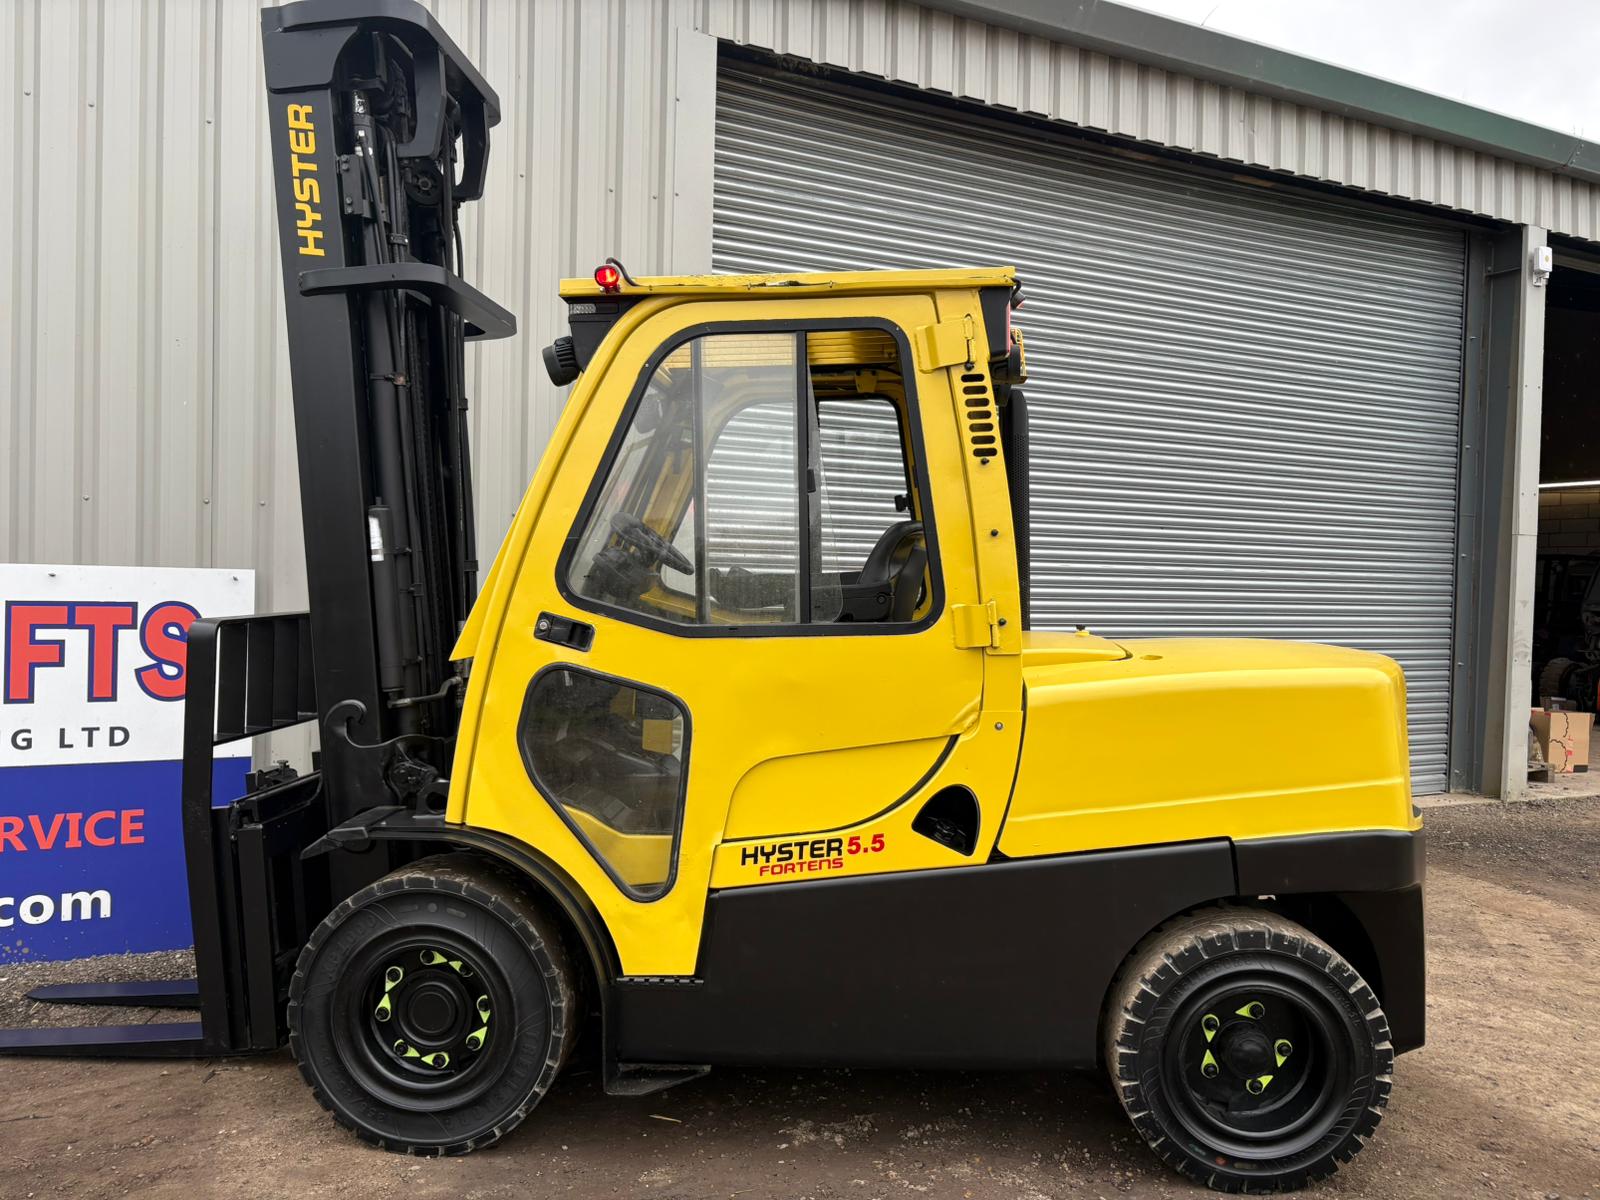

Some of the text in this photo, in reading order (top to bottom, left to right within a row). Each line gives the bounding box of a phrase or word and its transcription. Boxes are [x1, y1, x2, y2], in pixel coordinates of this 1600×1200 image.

[287, 103, 326, 257] HYSTER
[3, 601, 202, 705] FTS
[59, 726, 131, 750] LTD
[0, 808, 145, 853] RVICE
[741, 833, 885, 866] HYSTER 5.5
